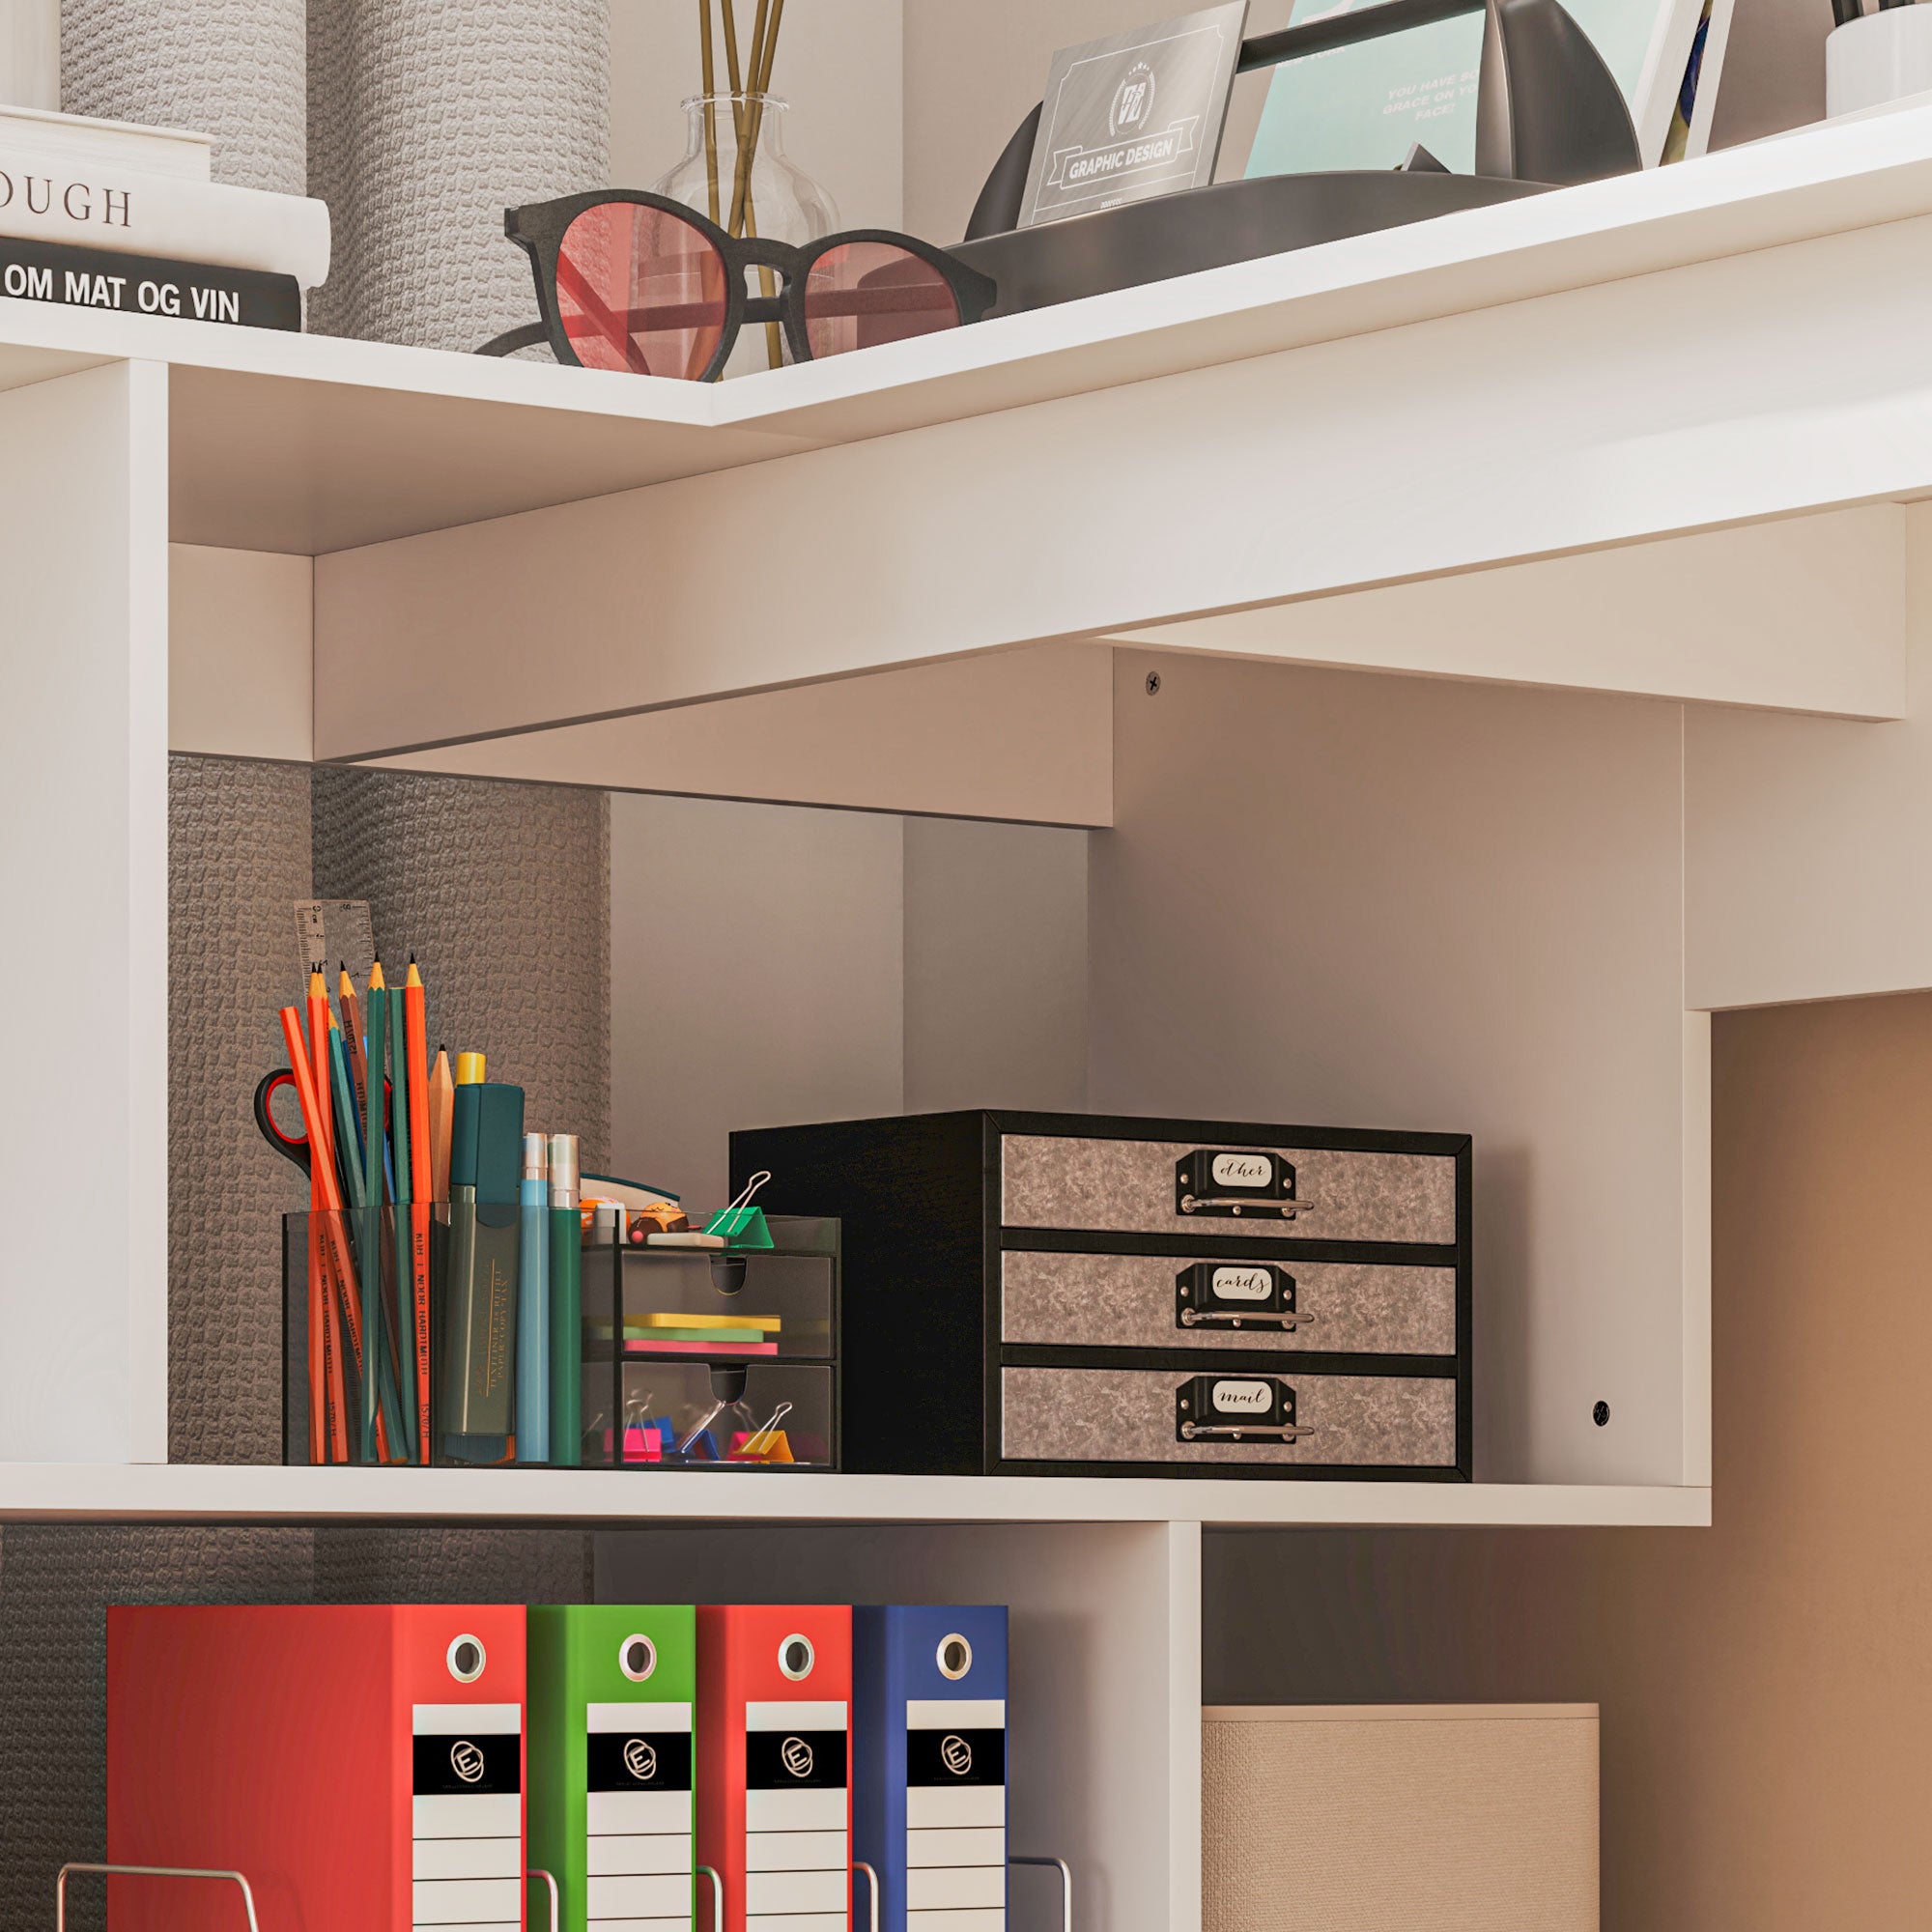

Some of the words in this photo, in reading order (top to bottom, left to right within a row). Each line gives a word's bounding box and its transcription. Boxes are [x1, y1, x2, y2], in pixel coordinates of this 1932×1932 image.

[1388, 85, 1417, 99] YOU
[1420, 74, 1457, 93] HAVE
[1383, 95, 1430, 114] GRACE
[1435, 89, 1455, 102] ON
[1415, 103, 1456, 122] FACE!
[1068, 151, 1125, 180] GRAPHIC
[1125, 138, 1174, 166] DESIGN
[5, 264, 53, 299] OM
[65, 271, 127, 308] MAT
[137, 281, 182, 316] OG
[190, 287, 240, 323] VIN
[415, 1233, 425, 1256] KOH
[321, 1274, 329, 1306] NOOR
[338, 1279, 351, 1311] NOOR
[416, 1274, 426, 1306] NOOR
[1217, 1272, 1271, 1294] cards
[418, 1310, 428, 1376] HARDTMUTH
[1218, 1388, 1265, 1405] mail
